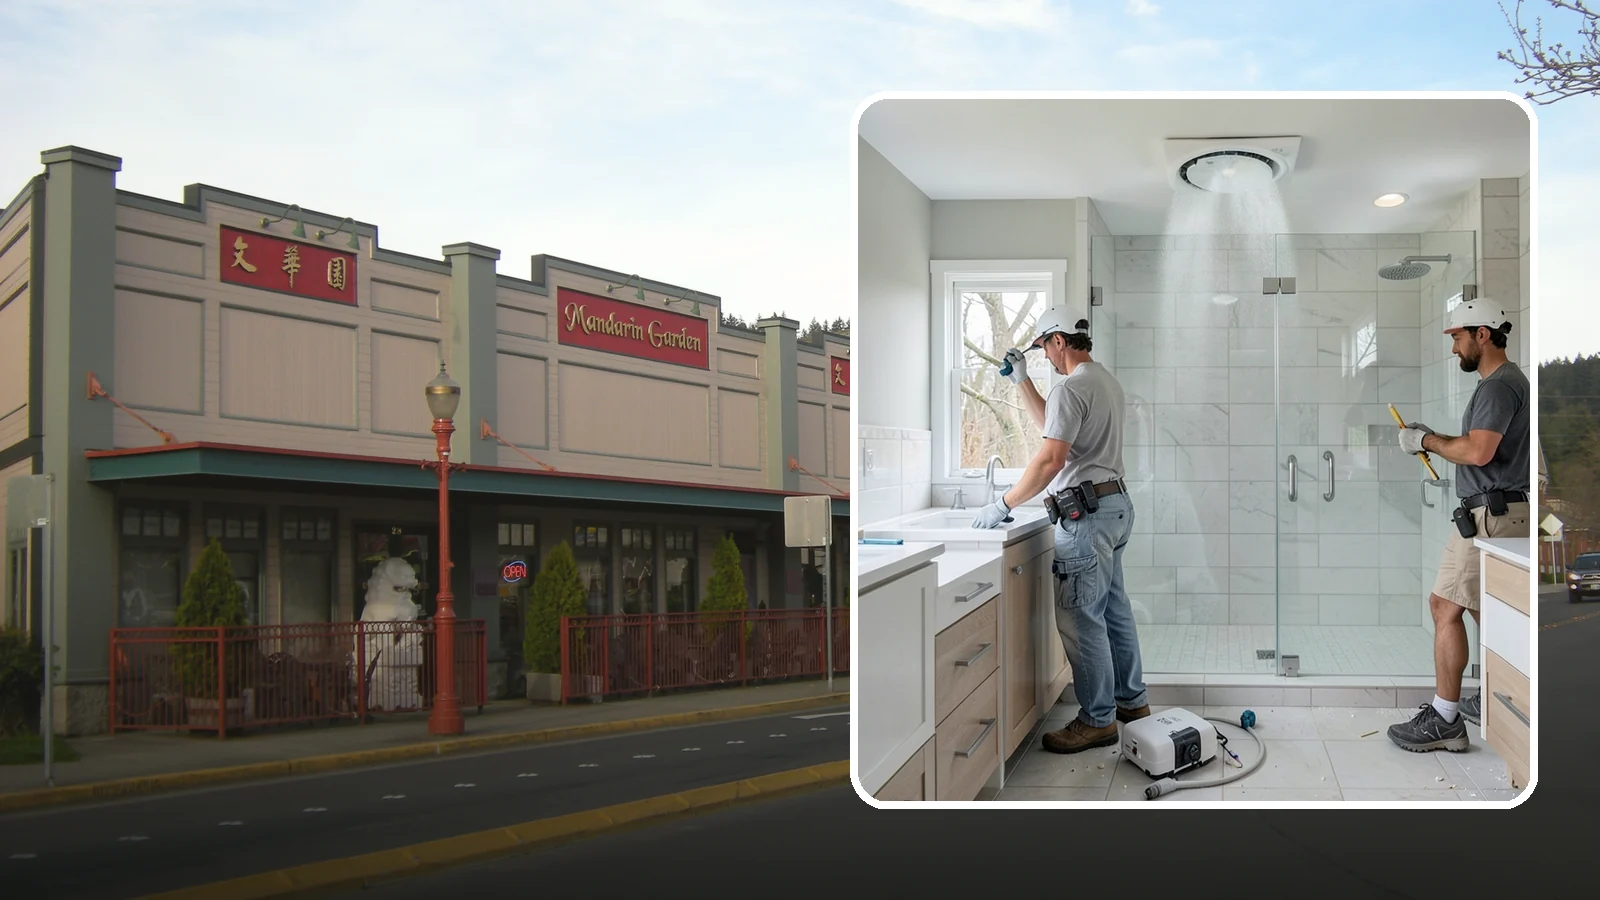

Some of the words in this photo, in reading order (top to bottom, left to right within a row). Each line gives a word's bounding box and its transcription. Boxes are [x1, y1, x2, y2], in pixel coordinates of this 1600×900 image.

[231, 235, 346, 290] 文華園
[564, 302, 644, 341] Mandarin
[647, 320, 701, 352] Garden
[835, 363, 846, 386] 文
[503, 565, 526, 578] OPEN
